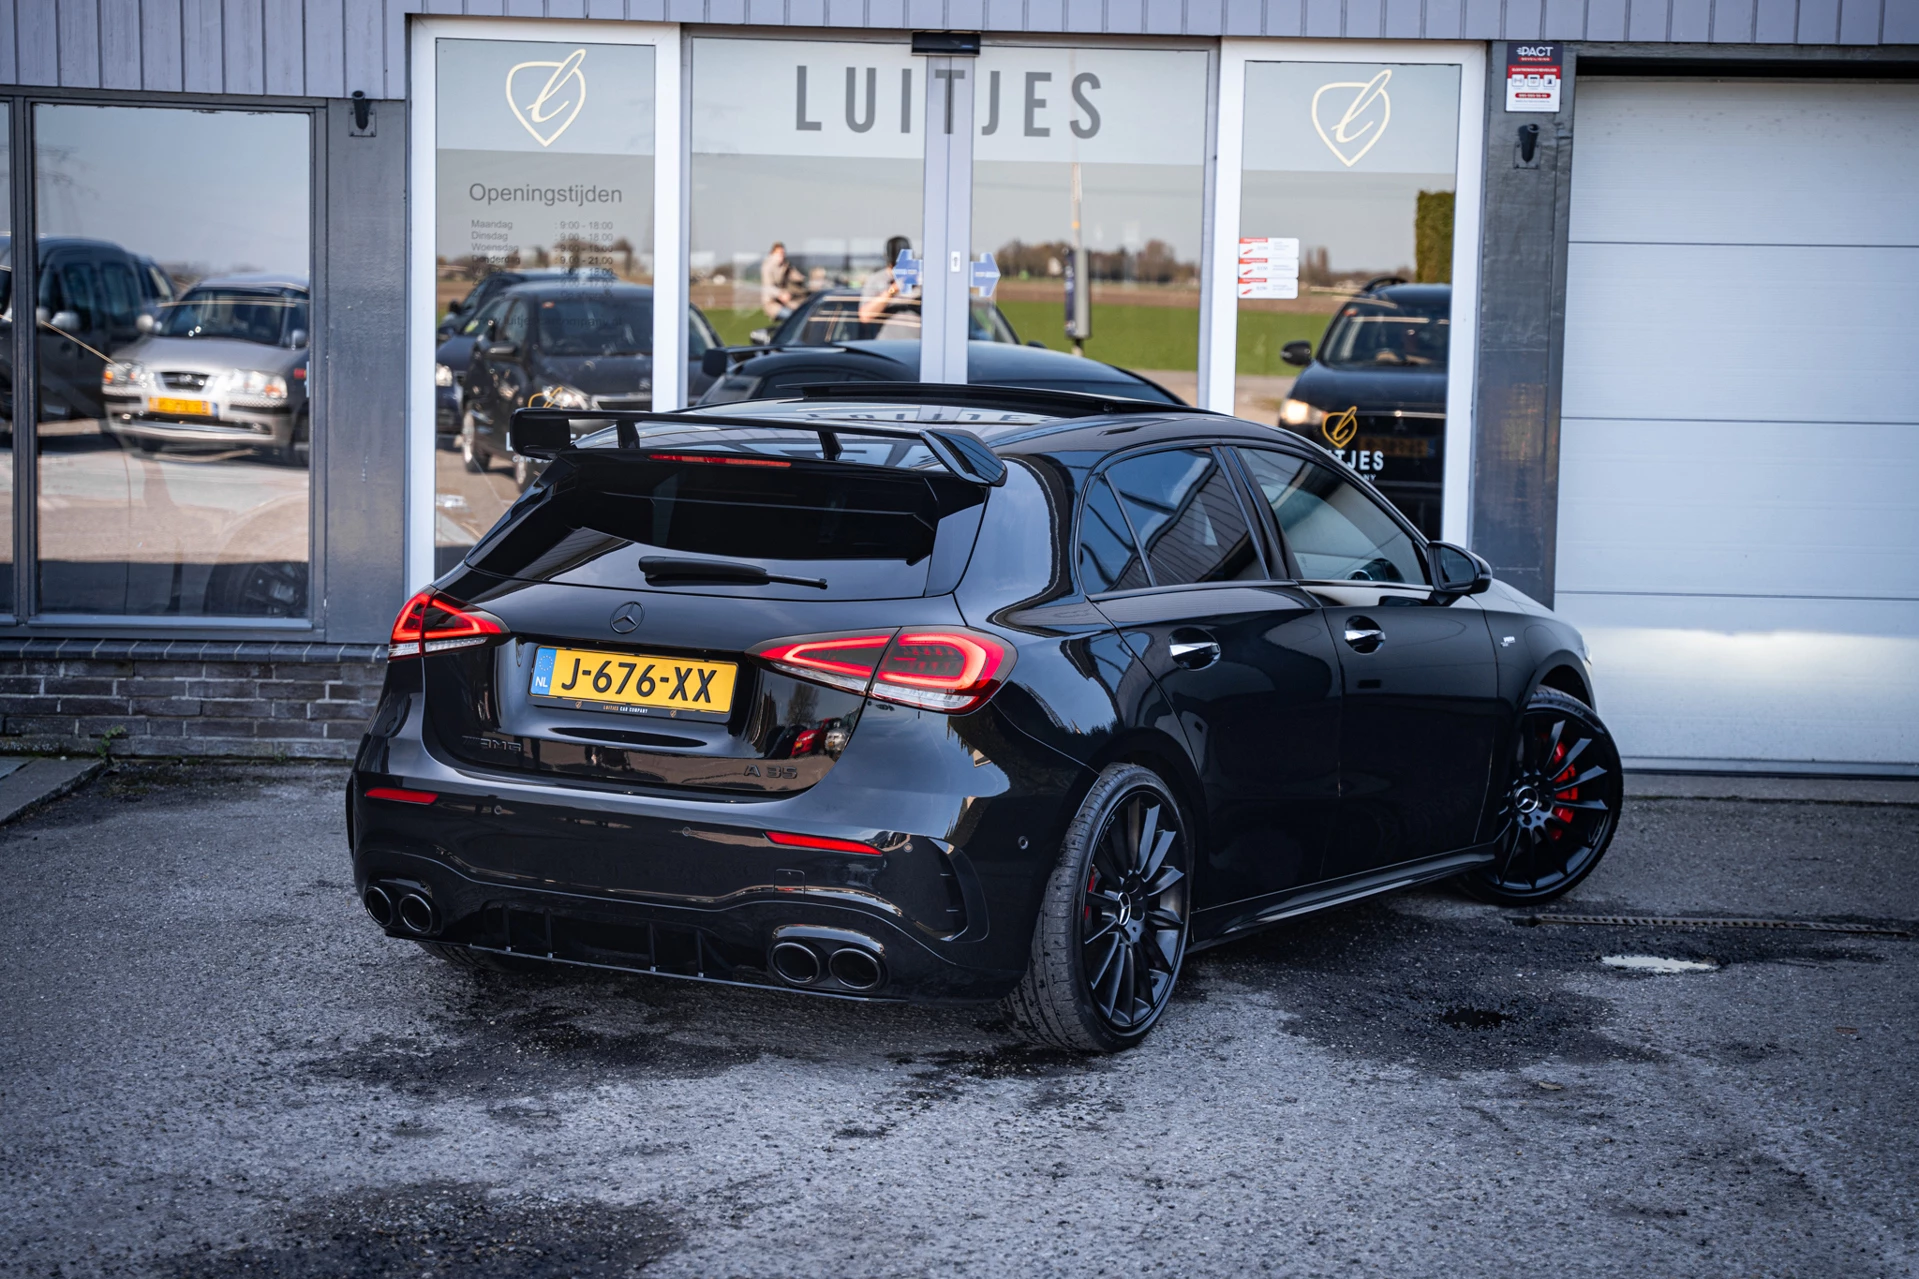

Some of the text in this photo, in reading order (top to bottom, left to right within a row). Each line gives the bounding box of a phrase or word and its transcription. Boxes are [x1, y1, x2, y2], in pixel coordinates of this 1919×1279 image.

[1520, 46, 1554, 57] PACT
[796, 65, 1102, 139] LUITJES
[469, 183, 622, 207] Openingstijden
[471, 219, 513, 231] Maandag
[471, 231, 509, 242] Dinsdag
[471, 243, 519, 255] Woensdag
[471, 255, 521, 265] Donderdag
[588, 256, 613, 265] 21.00
[1327, 449, 1384, 471] TJES
[535, 676, 549, 688] NL
[561, 658, 718, 703] J-676-XX
[480, 737, 521, 753] AMG
[744, 764, 798, 780] A 35
